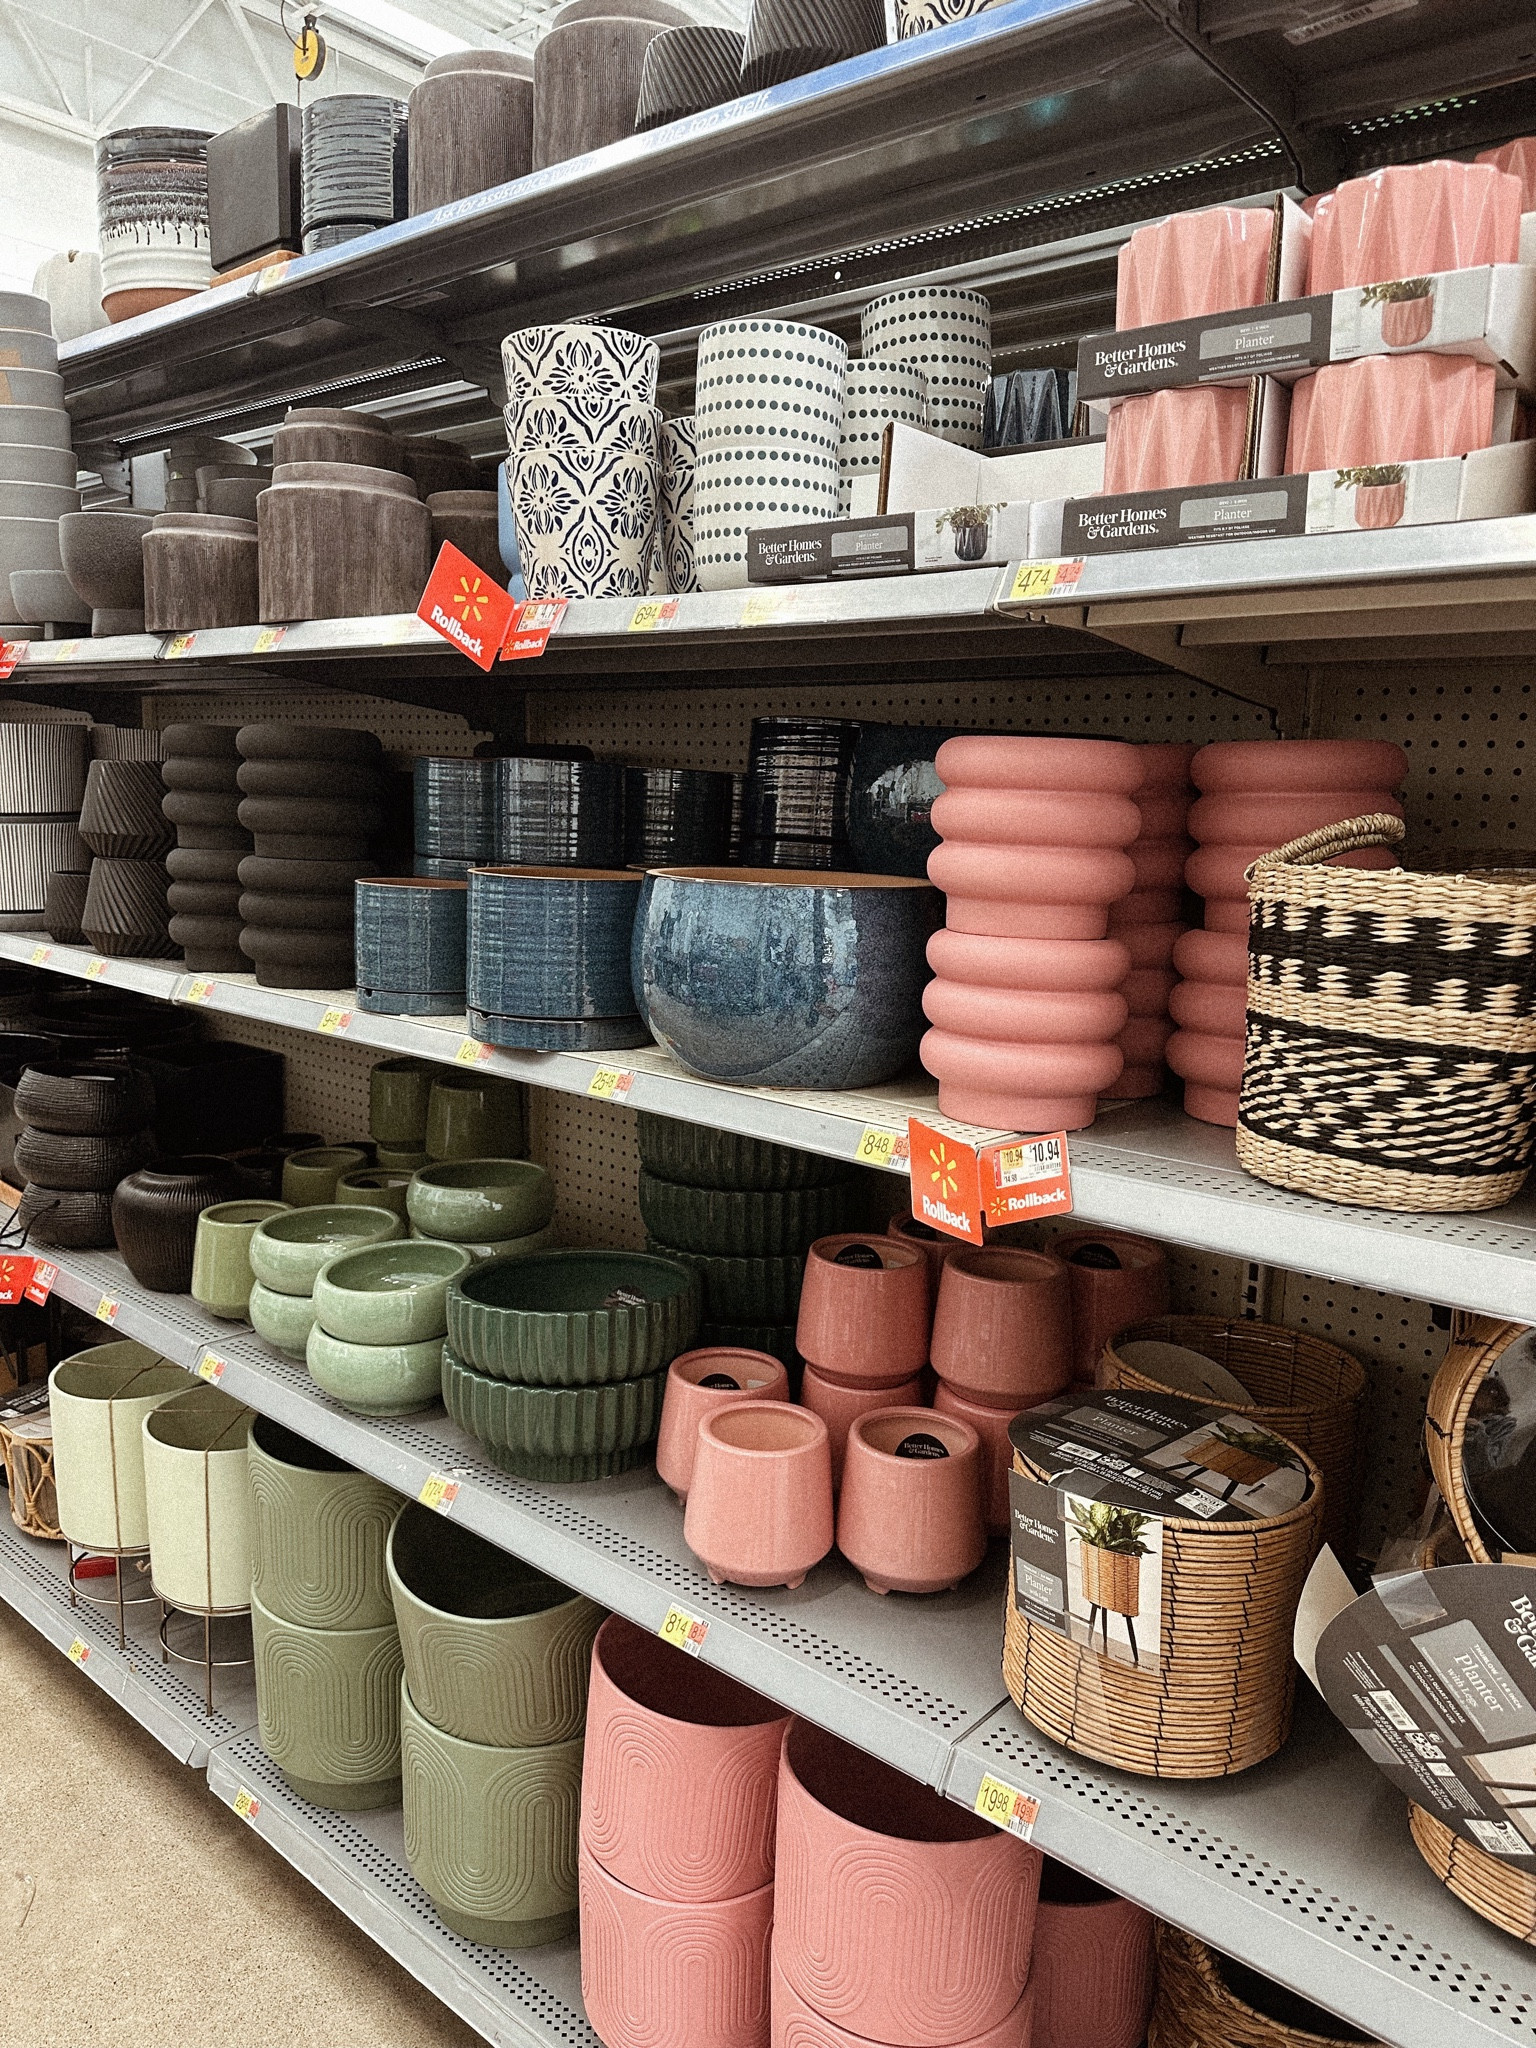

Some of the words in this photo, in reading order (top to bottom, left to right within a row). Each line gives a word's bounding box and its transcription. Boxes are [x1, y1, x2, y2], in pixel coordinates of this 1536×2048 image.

[456, 200, 477, 215] for
[477, 172, 550, 207] assistance
[723, 91, 771, 119] shelf
[1095, 349, 1136, 366] Better
[1138, 340, 1186, 358] Homes
[1235, 335, 1275, 350] Planter
[1078, 512, 1119, 528] Better
[1120, 508, 1167, 523] Homes
[1214, 509, 1252, 521] Planter
[758, 542, 787, 555] Better
[788, 539, 822, 552] Homes
[856, 541, 883, 552] Planter
[431, 605, 484, 658] Rollback
[1008, 1187, 1067, 1211] Rollback
[922, 1194, 972, 1233] Rollback
[1093, 1416, 1139, 1435] Planter
[1104, 1396, 1145, 1414] Better
[1143, 1407, 1188, 1430] Homes
[1014, 1509, 1034, 1526] Better
[1034, 1518, 1059, 1537] Homes
[1025, 1574, 1053, 1595] Planter
[1474, 1644, 1499, 1675] THURLOW
[1453, 1653, 1504, 1712] Planter
[1433, 1681, 1449, 1701] QUART
[1447, 1700, 1466, 1724] FOLIAGE
